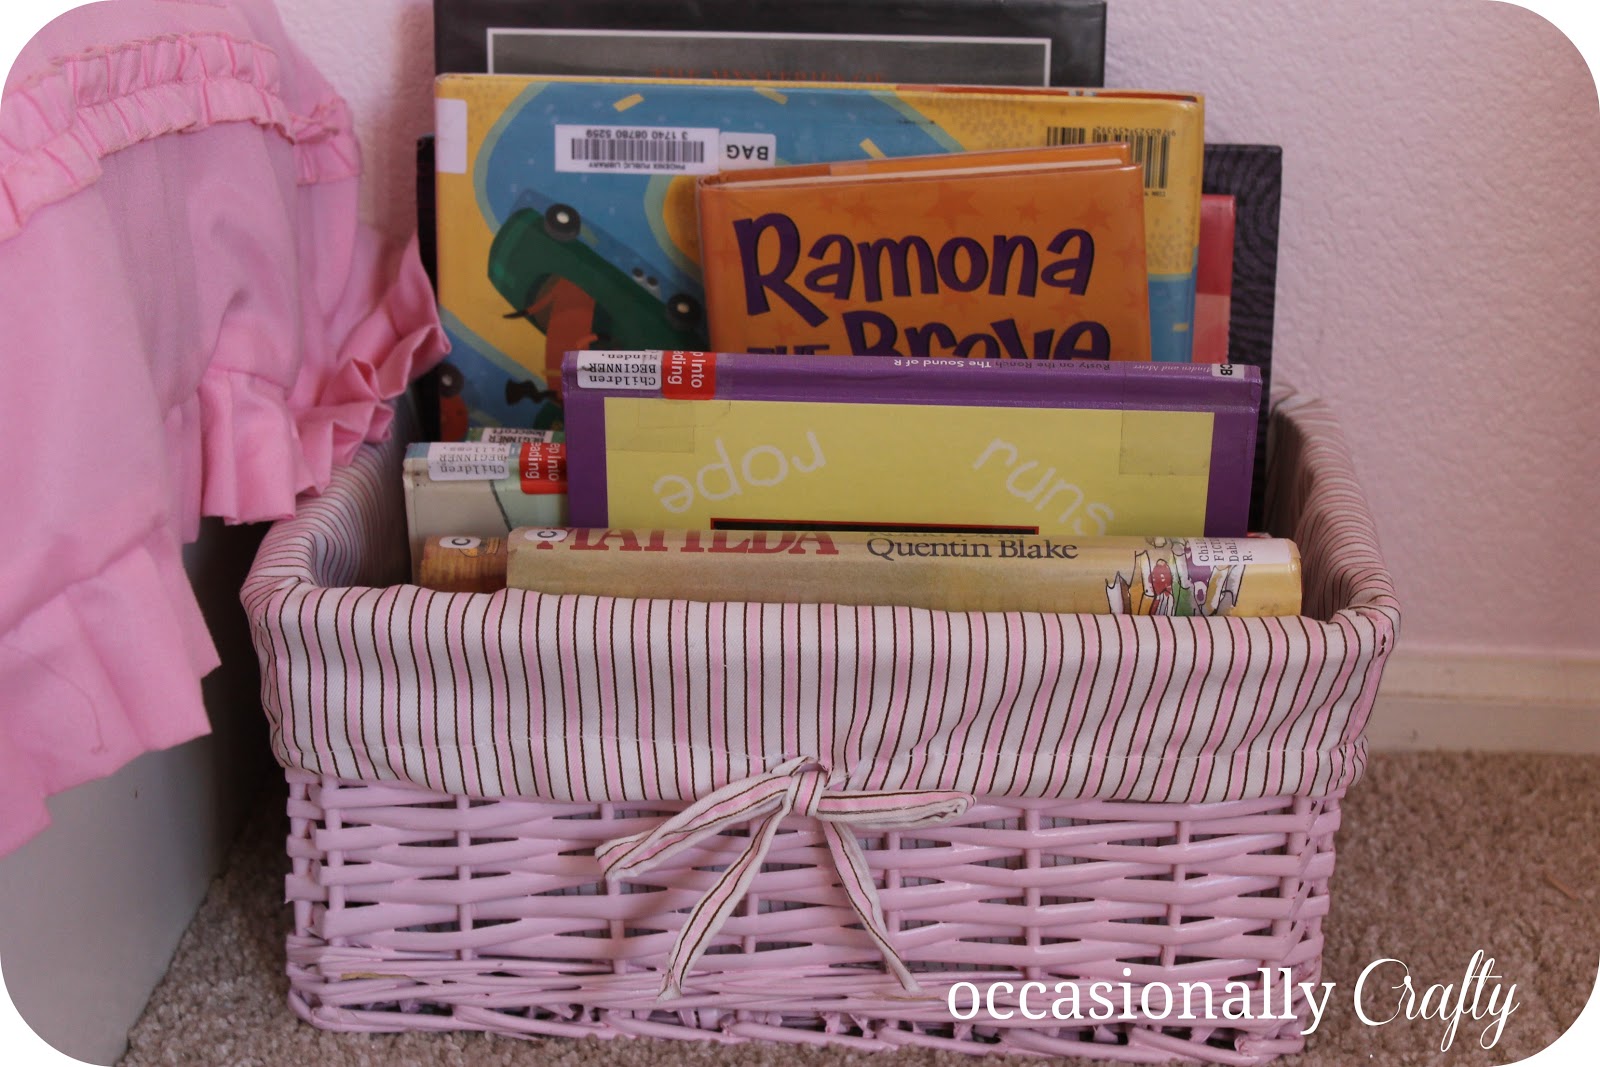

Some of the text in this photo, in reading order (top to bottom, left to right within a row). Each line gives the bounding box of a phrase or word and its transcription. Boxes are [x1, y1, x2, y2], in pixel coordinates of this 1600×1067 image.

[585, 128, 688, 140] 3 1740 08780 5259
[726, 144, 769, 161] BAG
[588, 161, 622, 169] LIBRARY
[624, 162, 651, 170] PUBLIC
[732, 212, 1095, 328] Ramona
[588, 363, 657, 374] BEGINNER
[893, 359, 992, 369] The Sound of R
[1037, 361, 1055, 369] the
[1079, 361, 1110, 371] Rusty
[691, 359, 706, 389] Into
[589, 375, 657, 386] Children
[439, 453, 506, 463] BEGINNER
[440, 464, 505, 474] Children
[652, 430, 828, 514] rope
[866, 537, 1079, 562] Quentin Blake
[1242, 550, 1254, 562] R.
